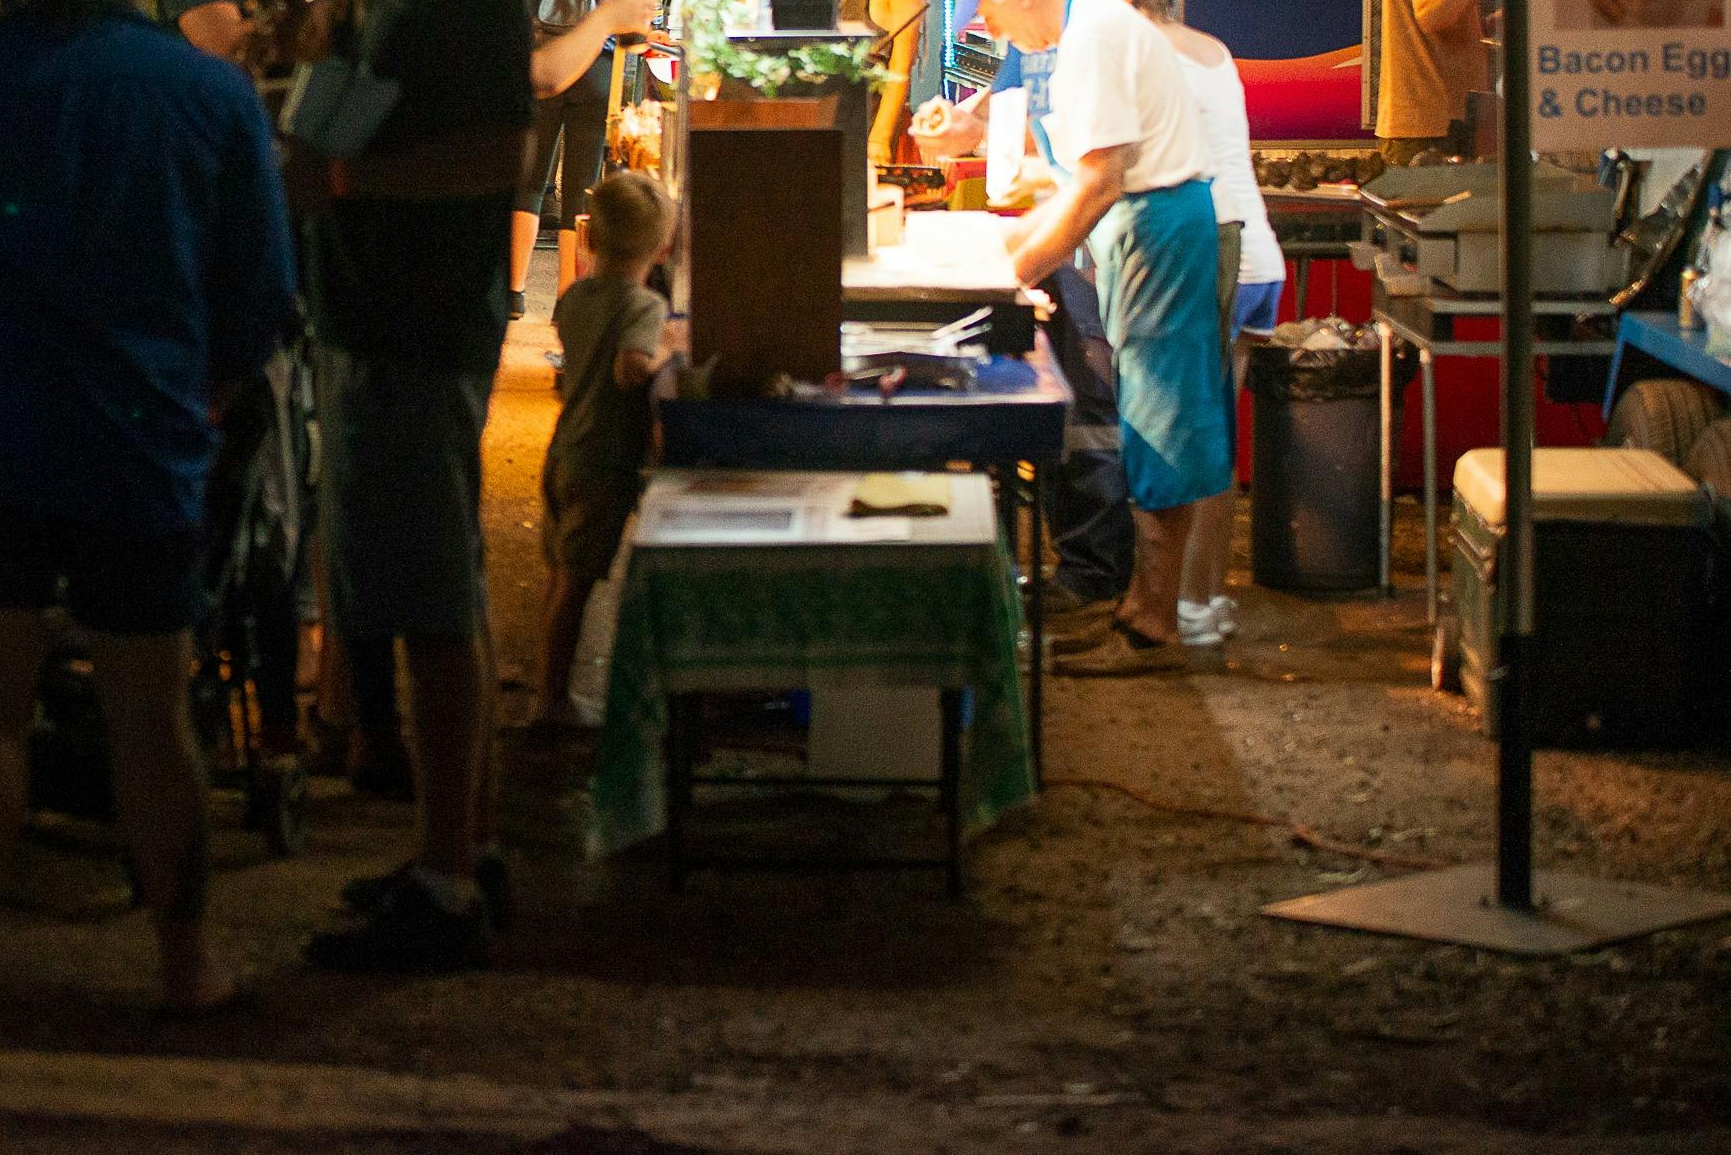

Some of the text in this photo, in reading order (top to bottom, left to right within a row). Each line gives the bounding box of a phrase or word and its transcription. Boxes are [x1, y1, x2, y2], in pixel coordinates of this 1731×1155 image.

[1538, 40, 1731, 81] Bacon Egg
[1537, 86, 1708, 119] & Cheese
